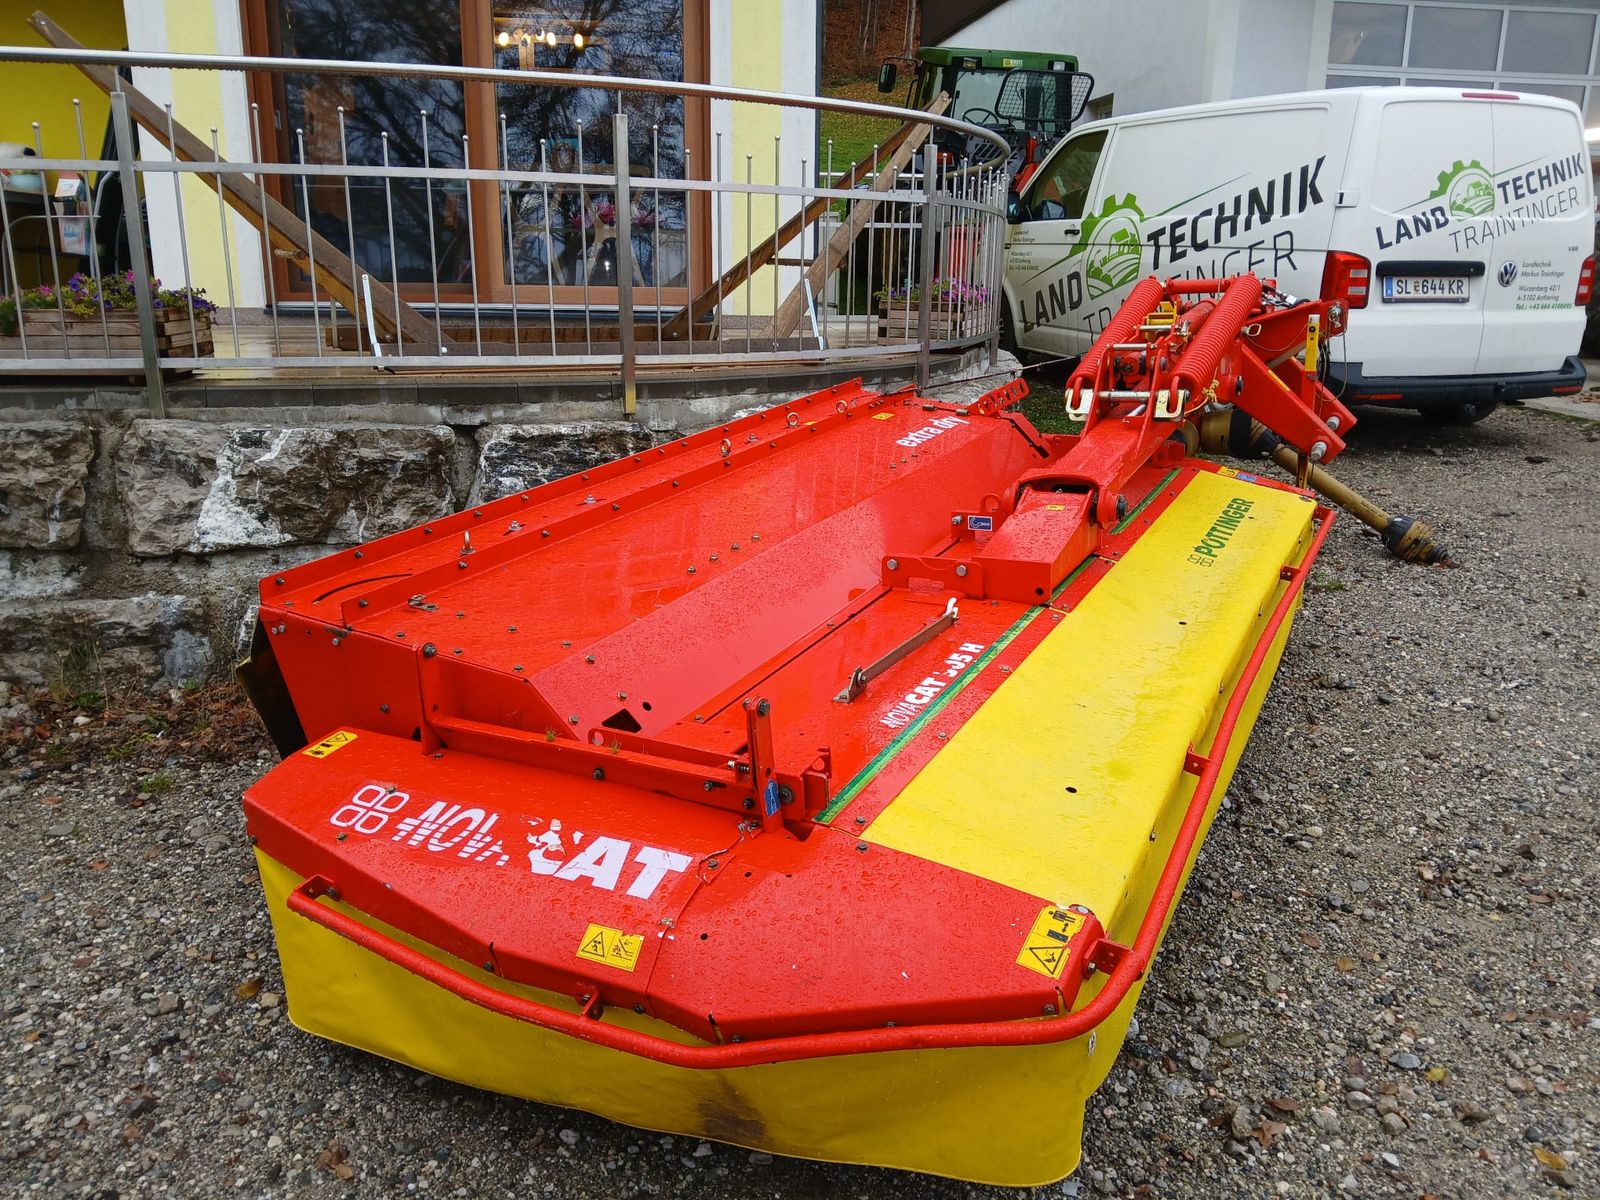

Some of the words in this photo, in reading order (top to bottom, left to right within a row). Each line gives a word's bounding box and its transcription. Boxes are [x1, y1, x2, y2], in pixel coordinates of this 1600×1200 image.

[1375, 205, 1449, 249] LAND
[1497, 152, 1584, 205] TECHNIK
[1448, 186, 1580, 253] TRAINTINGER
[1020, 270, 1082, 333] LAND
[1146, 155, 1326, 270] TECHNIK
[1396, 279, 1411, 295] SL
[1421, 279, 1445, 295] 644
[1448, 279, 1464, 295] KR
[895, 426, 945, 447] extra
[928, 415, 971, 429] dry
